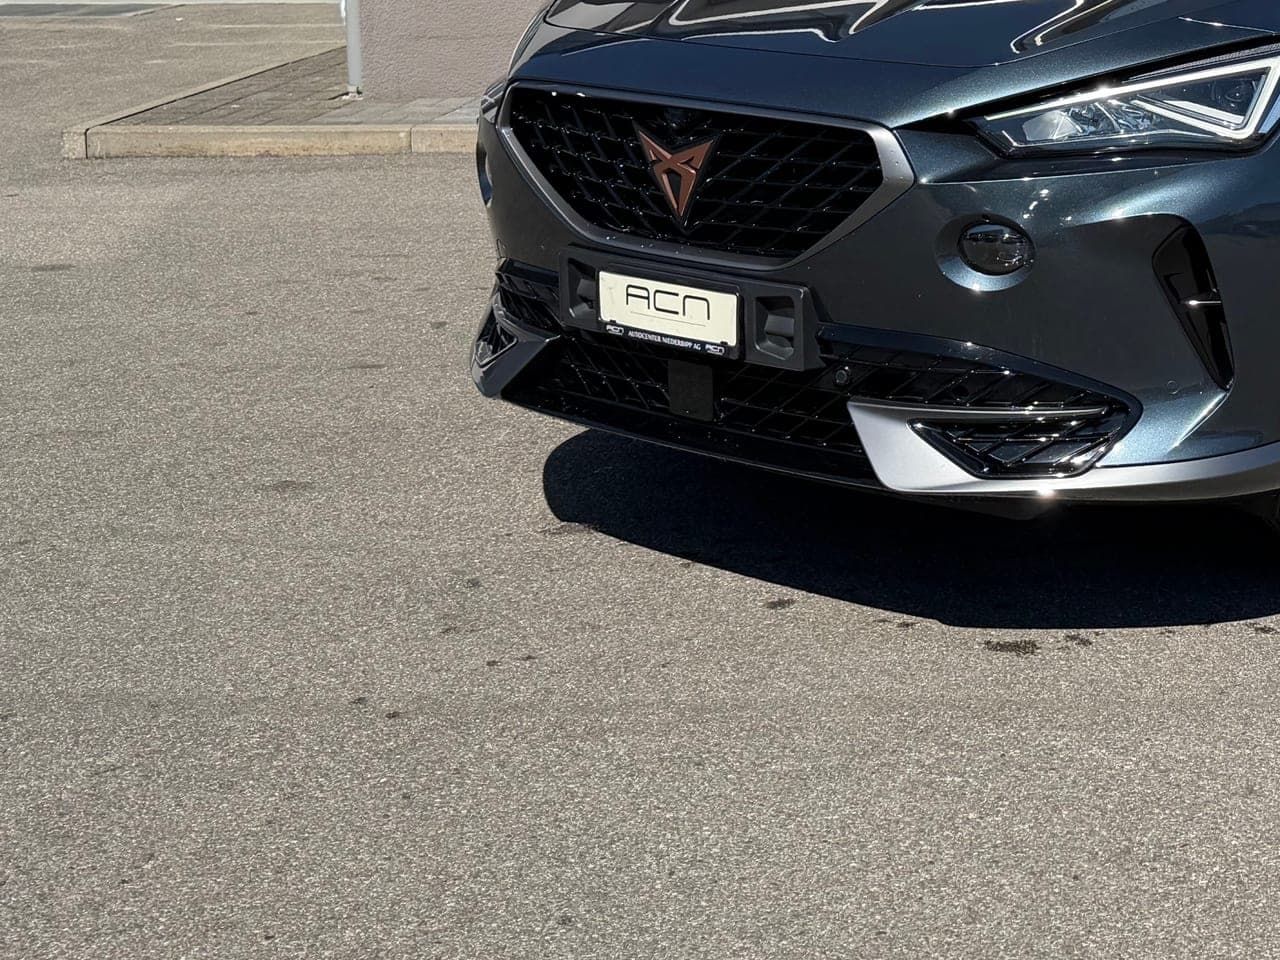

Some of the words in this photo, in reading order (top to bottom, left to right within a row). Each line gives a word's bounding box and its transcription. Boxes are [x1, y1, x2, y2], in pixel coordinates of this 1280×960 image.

[626, 285, 710, 320] ACN
[628, 331, 661, 342] AUTOCENTER
[693, 343, 702, 351] AG
